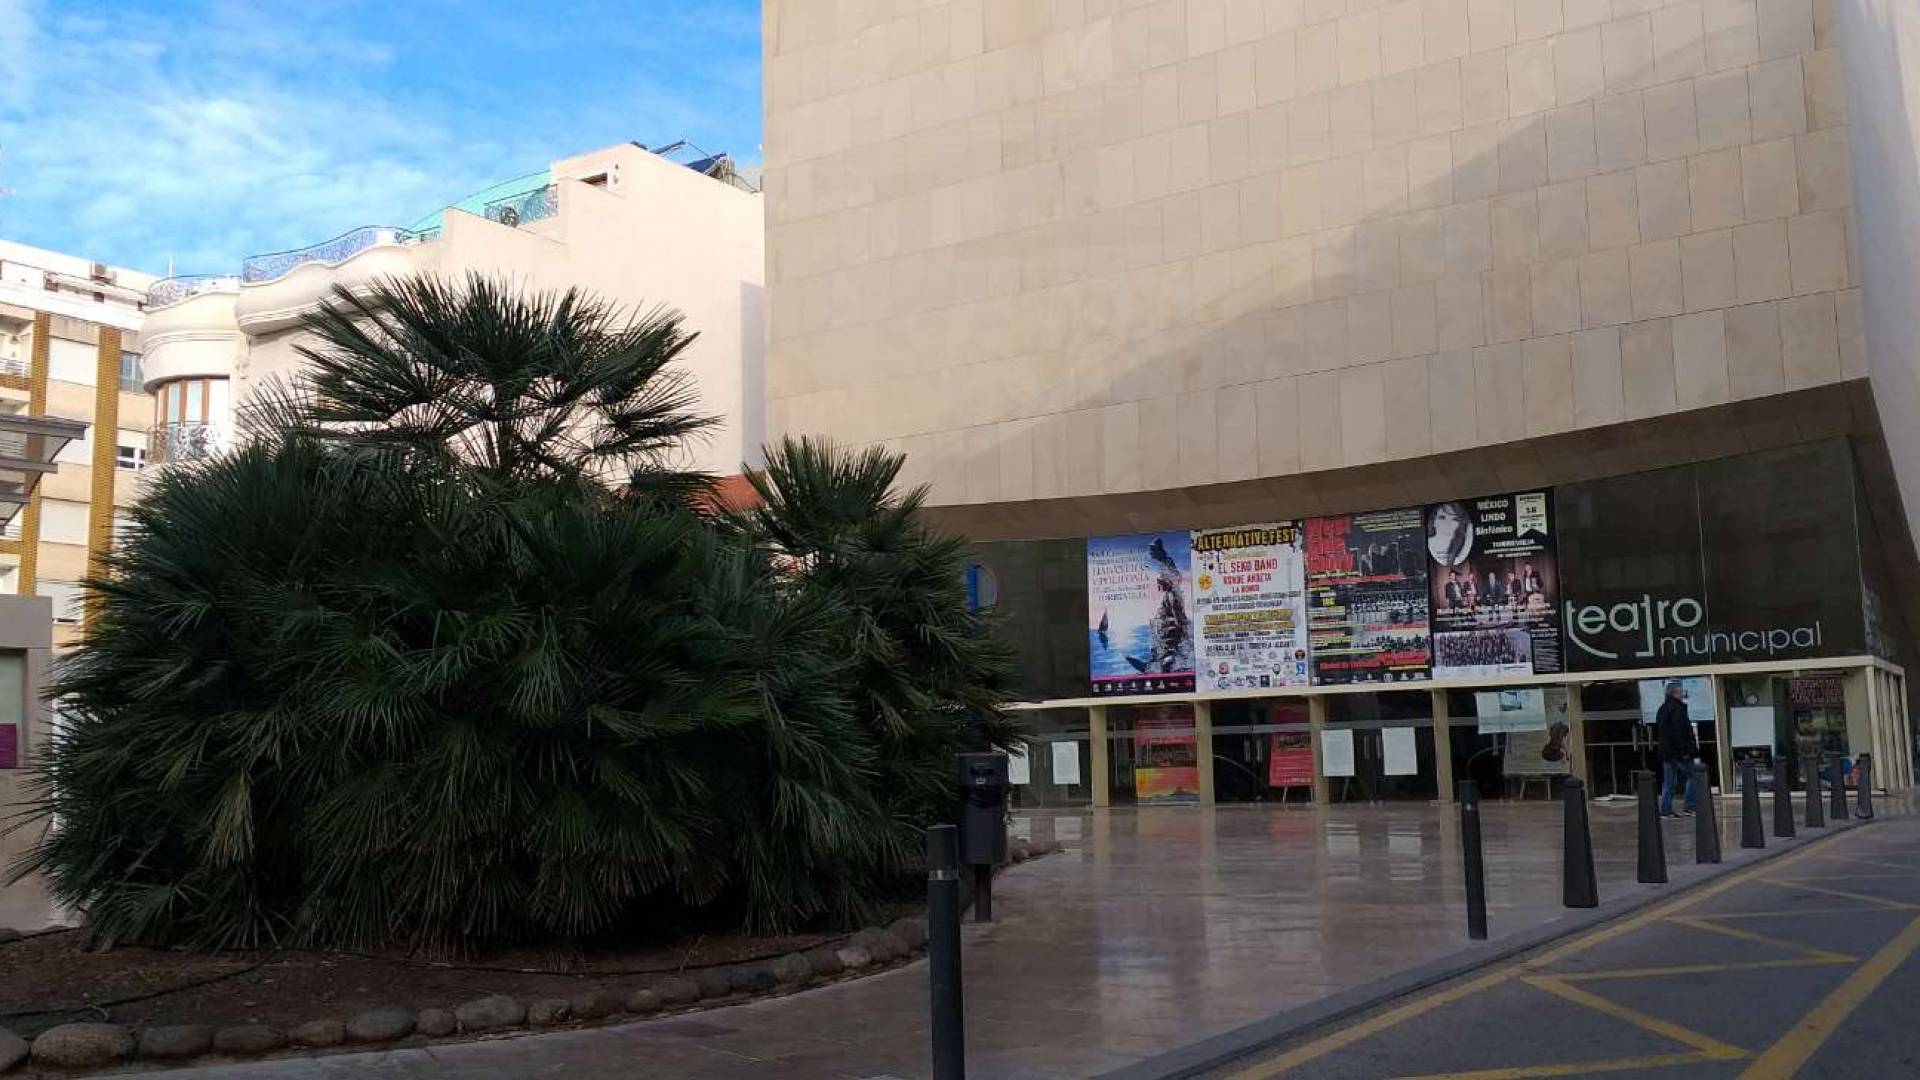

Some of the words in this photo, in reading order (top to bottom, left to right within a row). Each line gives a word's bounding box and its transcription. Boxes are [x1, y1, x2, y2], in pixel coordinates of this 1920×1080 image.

[1481, 512, 1506, 522] LINDO
[1196, 530, 1269, 551] ALTERNATIVE
[1270, 527, 1296, 543] FEST
[1218, 562, 1227, 573] EL
[1566, 594, 1703, 659] teatro
[1660, 620, 1822, 656] municipal
